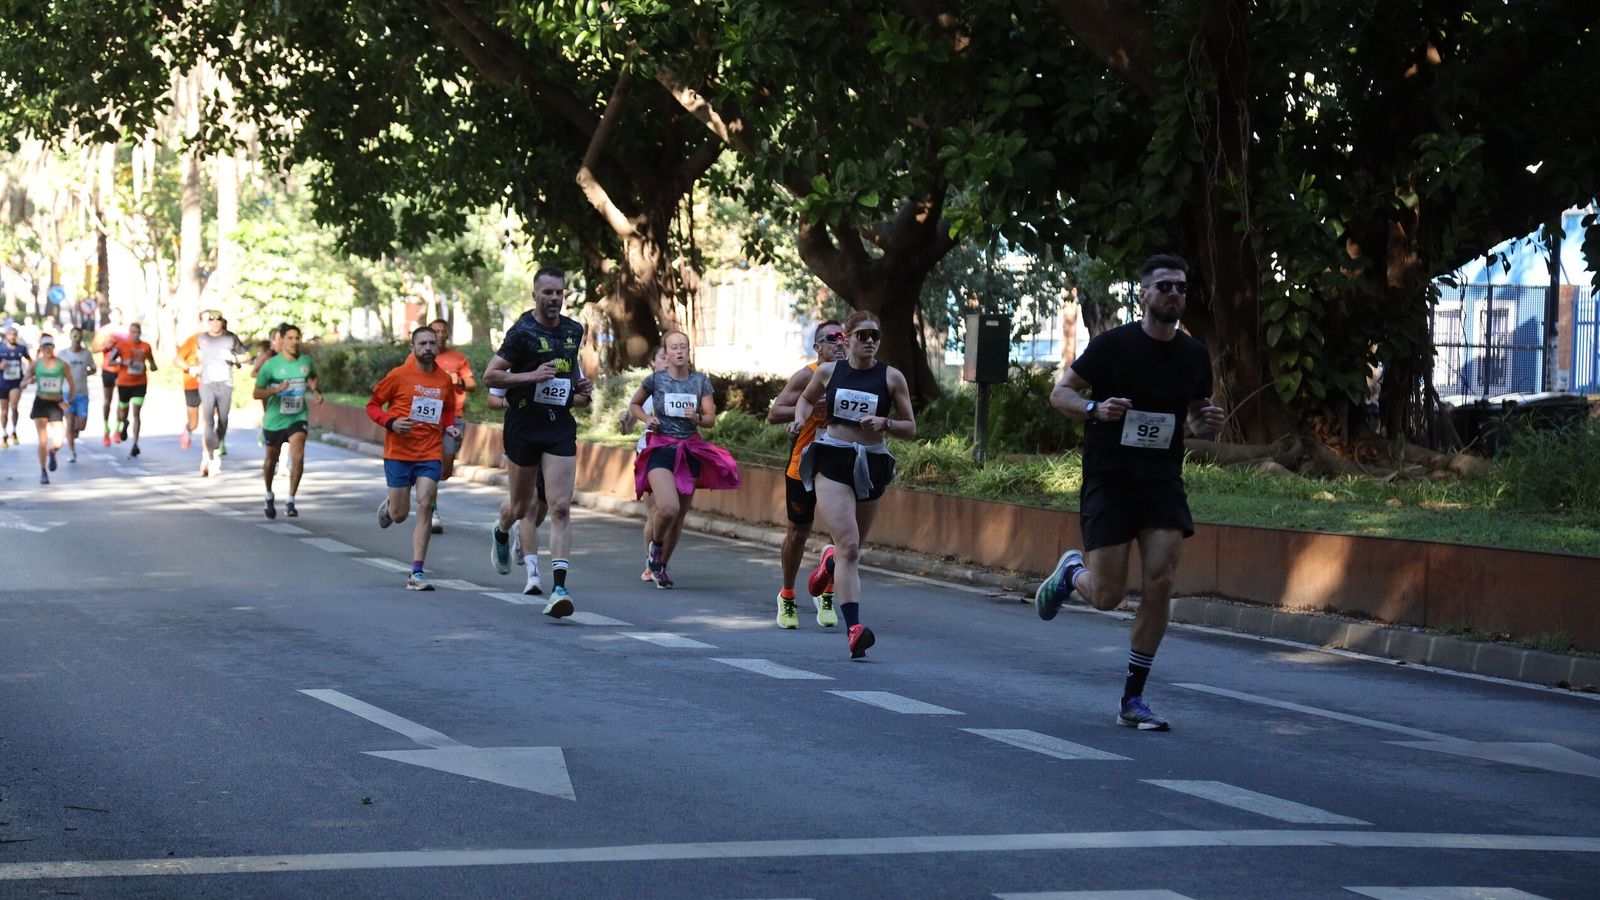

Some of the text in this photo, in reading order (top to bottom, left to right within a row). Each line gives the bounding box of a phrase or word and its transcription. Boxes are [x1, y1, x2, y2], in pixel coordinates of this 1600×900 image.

[542, 386, 566, 397] 422
[416, 405, 437, 416] 151
[840, 399, 869, 413] 972
[1137, 424, 1160, 438] 92
